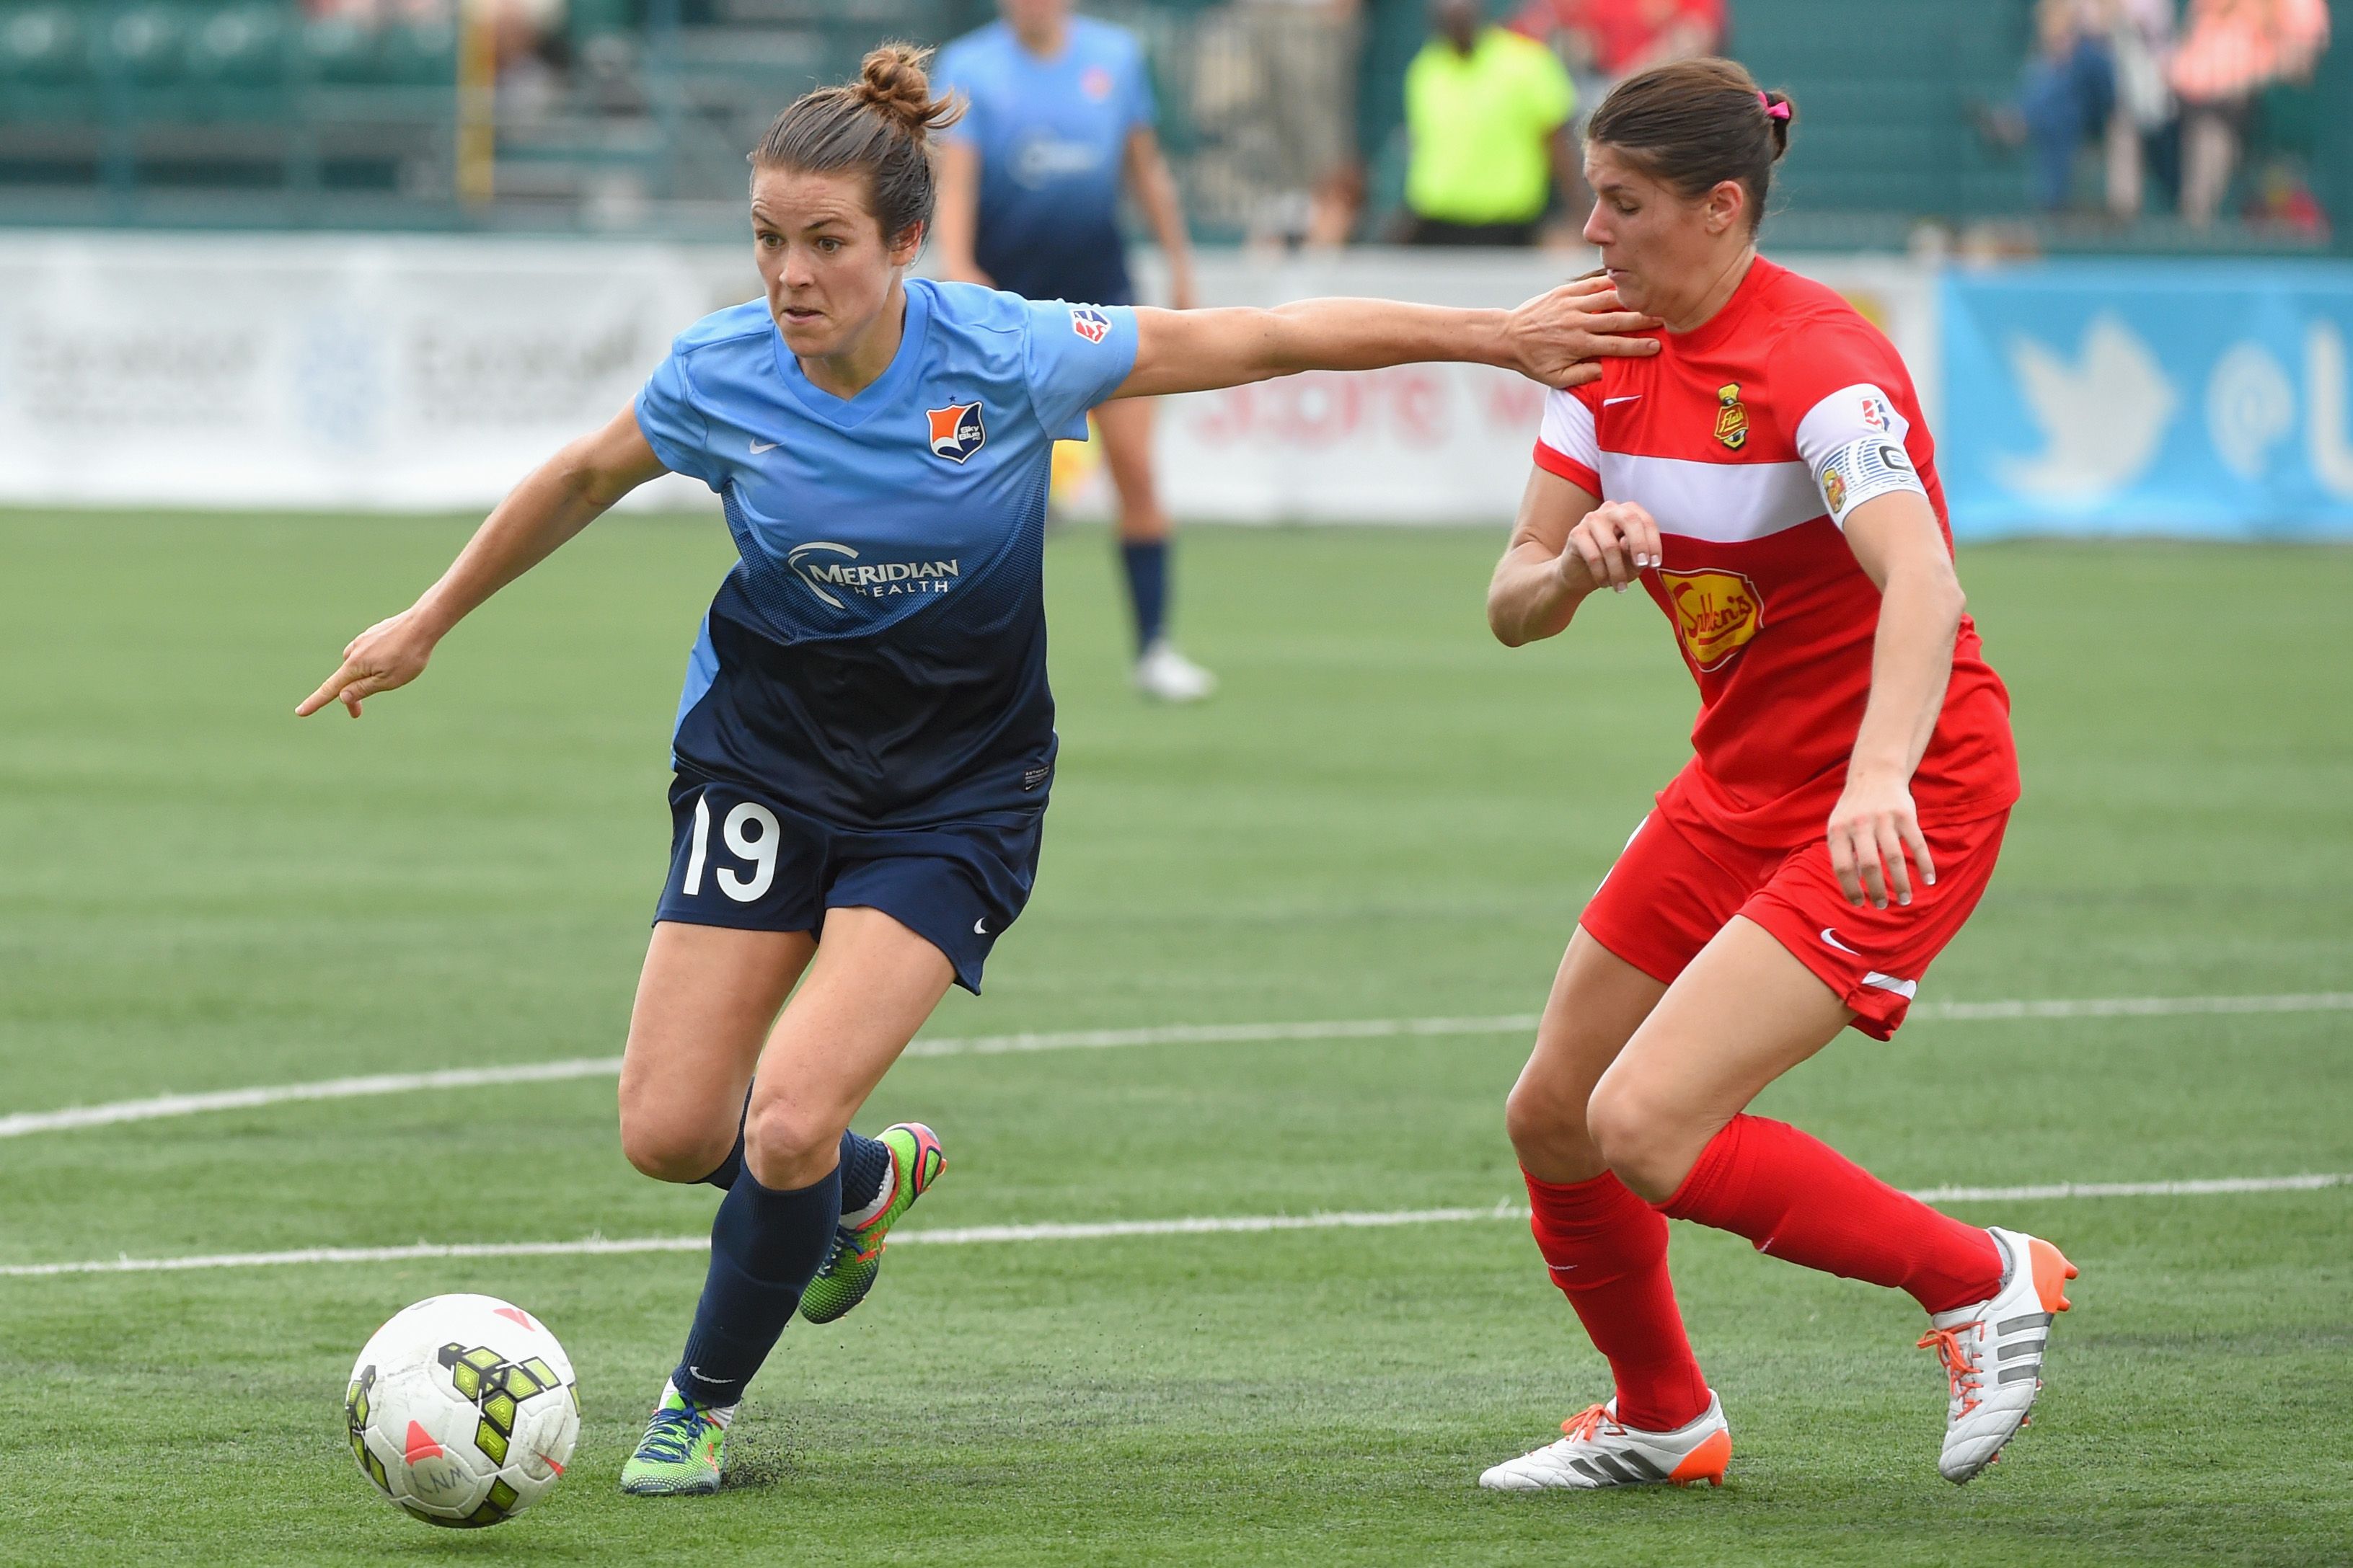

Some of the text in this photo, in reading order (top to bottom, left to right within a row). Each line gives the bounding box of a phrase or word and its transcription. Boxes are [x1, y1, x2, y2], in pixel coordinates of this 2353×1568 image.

[958, 432, 980, 440] Blue
[1879, 445, 1912, 472] C
[855, 580, 949, 598] HEALTH
[682, 794, 781, 903] 19
